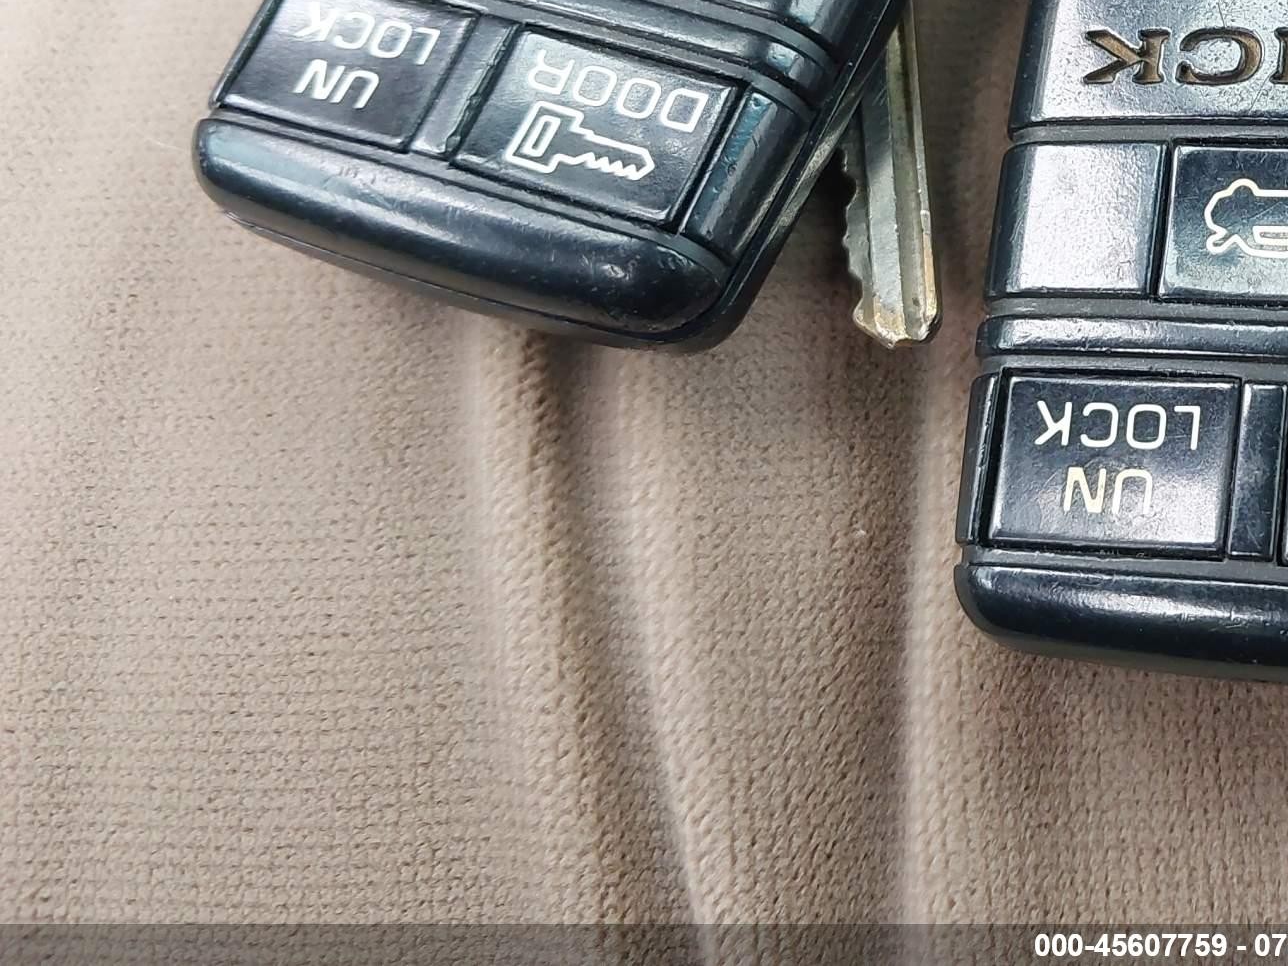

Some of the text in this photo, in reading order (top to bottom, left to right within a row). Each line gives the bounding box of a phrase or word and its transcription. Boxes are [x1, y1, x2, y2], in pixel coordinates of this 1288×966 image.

[296, 0, 441, 66] LOCK
[294, 58, 380, 111] UN
[527, 49, 709, 133] DOOR
[1034, 401, 1200, 451] LOCK
[1063, 466, 1153, 515] UN
